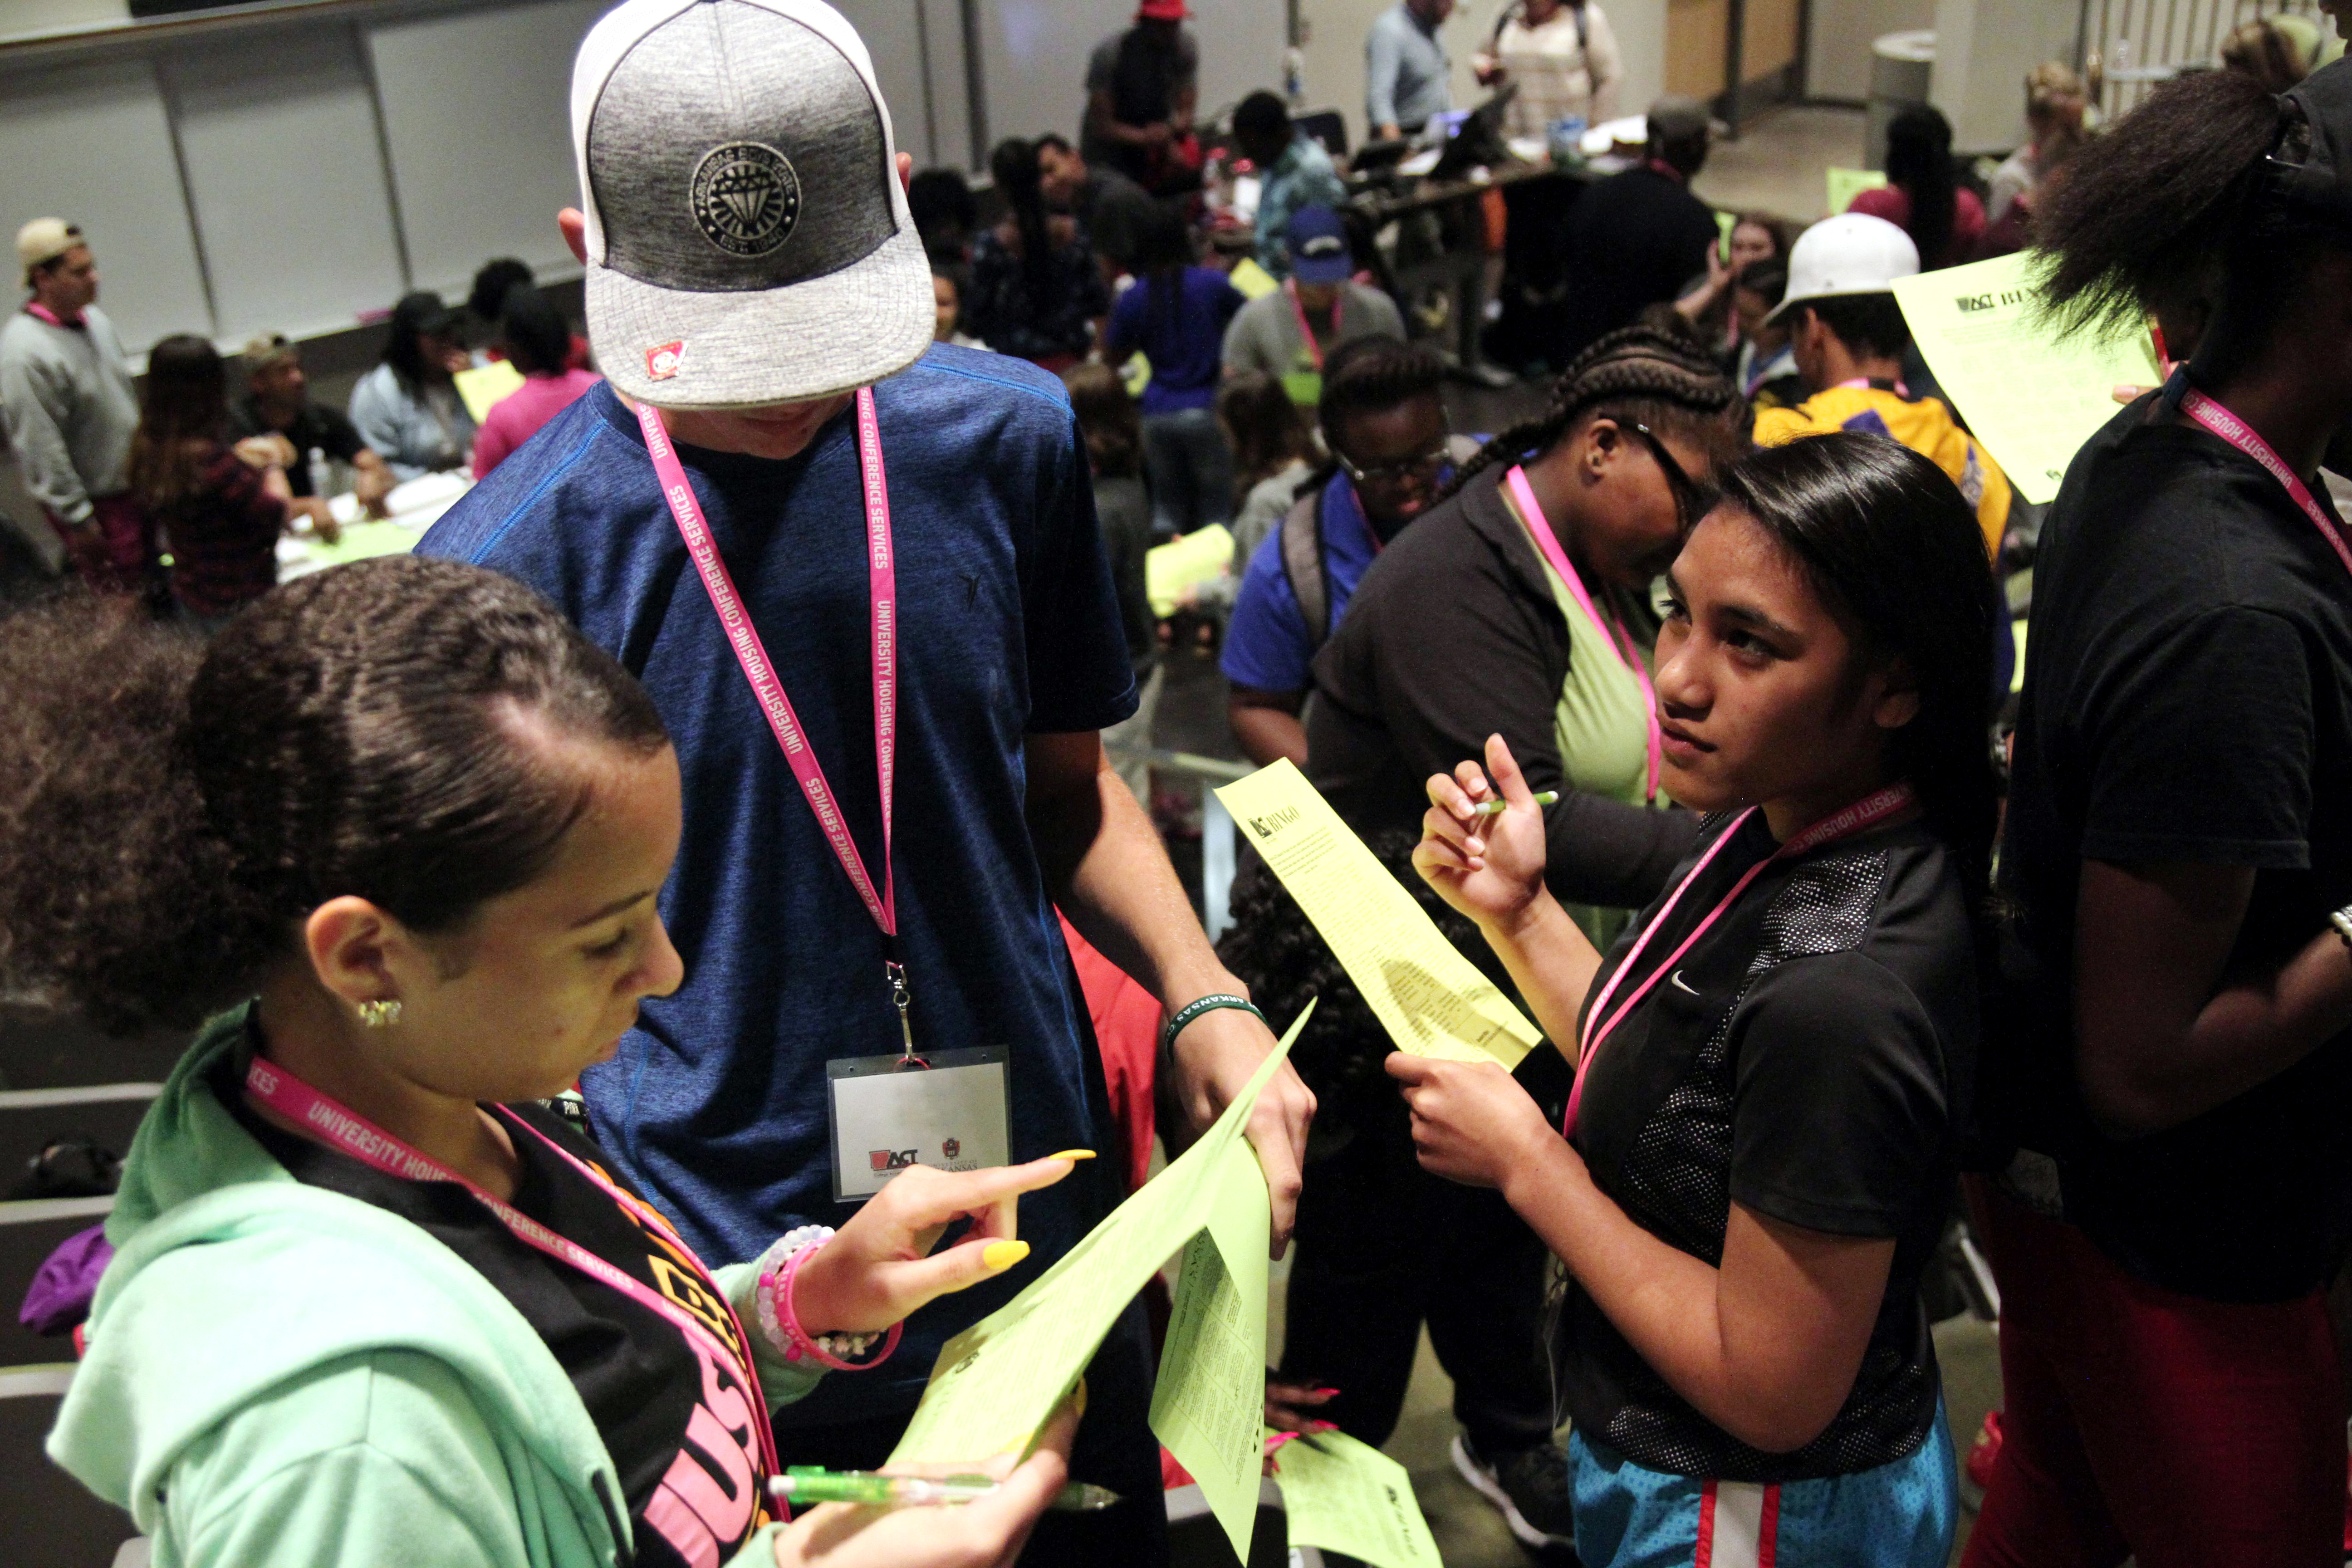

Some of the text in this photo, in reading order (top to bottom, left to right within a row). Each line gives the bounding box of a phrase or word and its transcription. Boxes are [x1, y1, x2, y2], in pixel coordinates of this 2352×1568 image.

[863, 422, 882, 510] CONFERENCE
[2195, 402, 2293, 489] UNIVERSITY HOUSING
[870, 509, 888, 570] SERVICES
[669, 485, 804, 755] UNIVERSITY HOUSING CONFERENCE SERVICES
[877, 600, 893, 676] UNIVERSITY
[878, 680, 893, 735] HOUSING
[806, 777, 843, 833] SERVICES
[881, 738, 892, 818] CONFERENCE
[1265, 805, 1300, 833] BINGO
[1804, 810, 1858, 846] HOUSING
[832, 833, 875, 903] CONFERENCE
[1638, 886, 1685, 945] CONFERENCE
[1176, 995, 1245, 1022] ARKANSAS
[886, 1149, 918, 1169] ACT
[308, 1101, 406, 1168] UNIVERSITY
[567, 1244, 634, 1289] SERVICES
